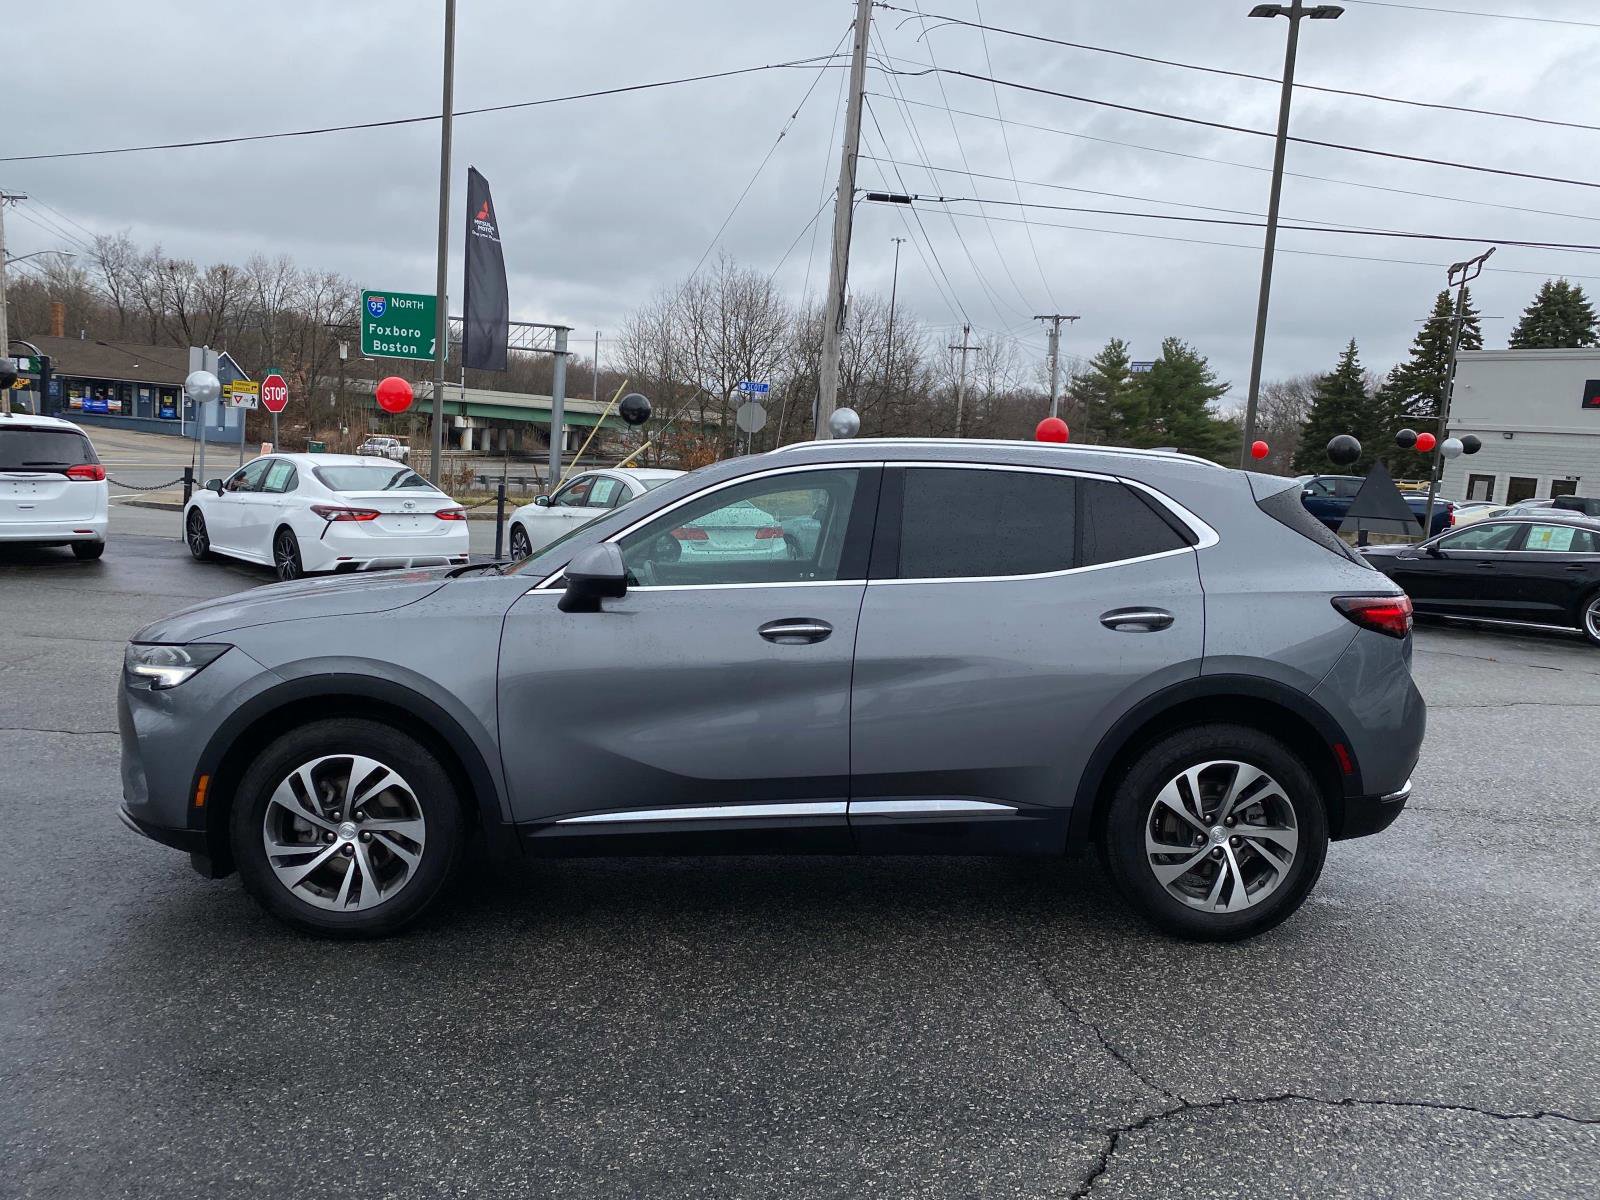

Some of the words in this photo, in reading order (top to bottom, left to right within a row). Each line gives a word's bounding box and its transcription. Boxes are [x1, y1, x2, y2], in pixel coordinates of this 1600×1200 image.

[371, 302, 383, 313] 95
[391, 297, 424, 310] NORTH
[369, 323, 421, 338] Foxboro
[373, 339, 417, 354] Boston
[264, 387, 286, 401] STOP
